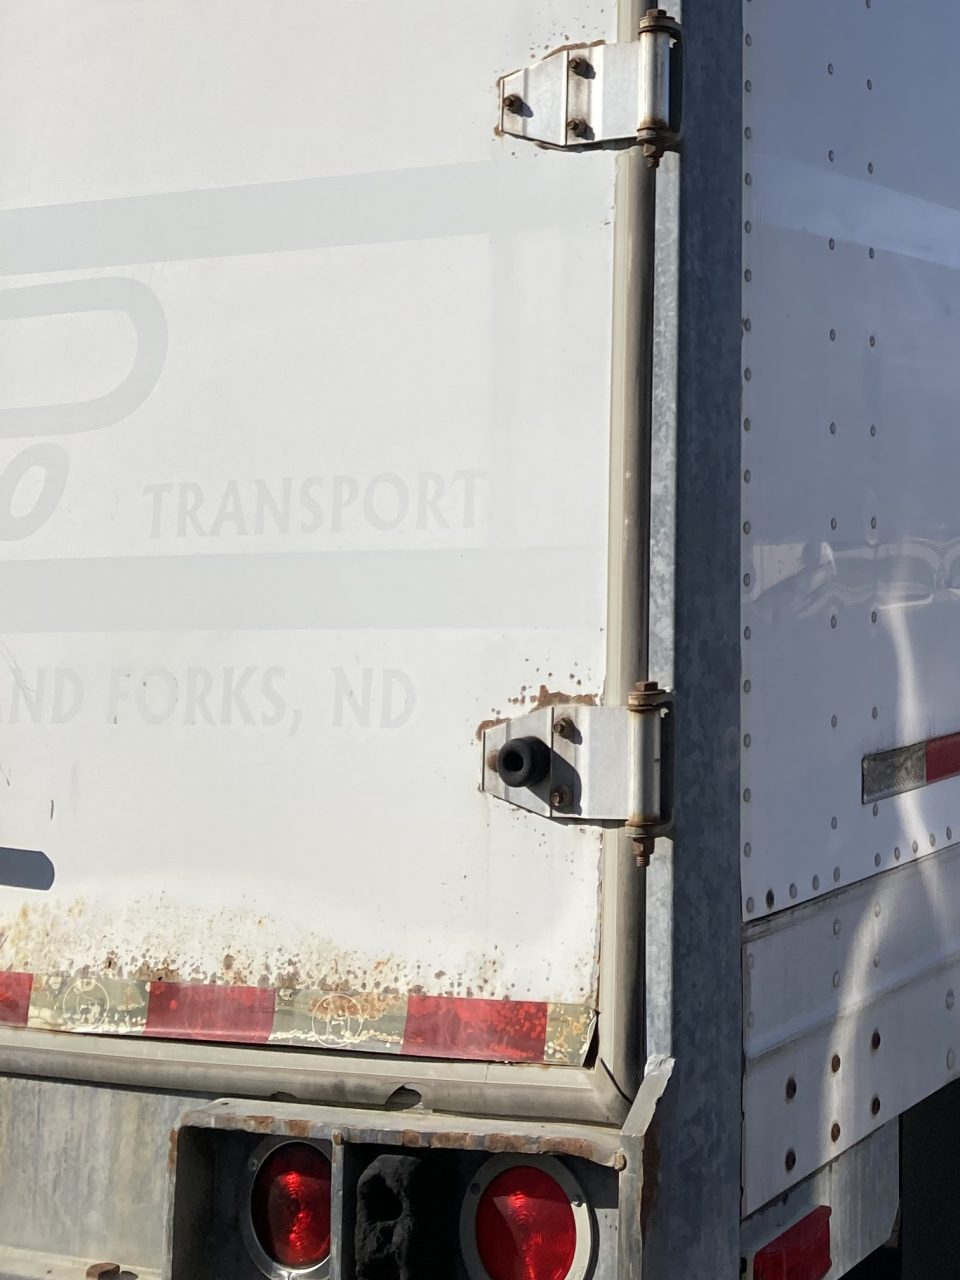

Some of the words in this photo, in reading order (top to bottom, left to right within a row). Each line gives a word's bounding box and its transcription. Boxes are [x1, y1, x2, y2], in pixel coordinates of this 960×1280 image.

[142, 467, 489, 540] TRANSPORT
[0, 665, 84, 726] ND
[109, 665, 304, 739] FORKS,
[329, 666, 417, 730] ND
